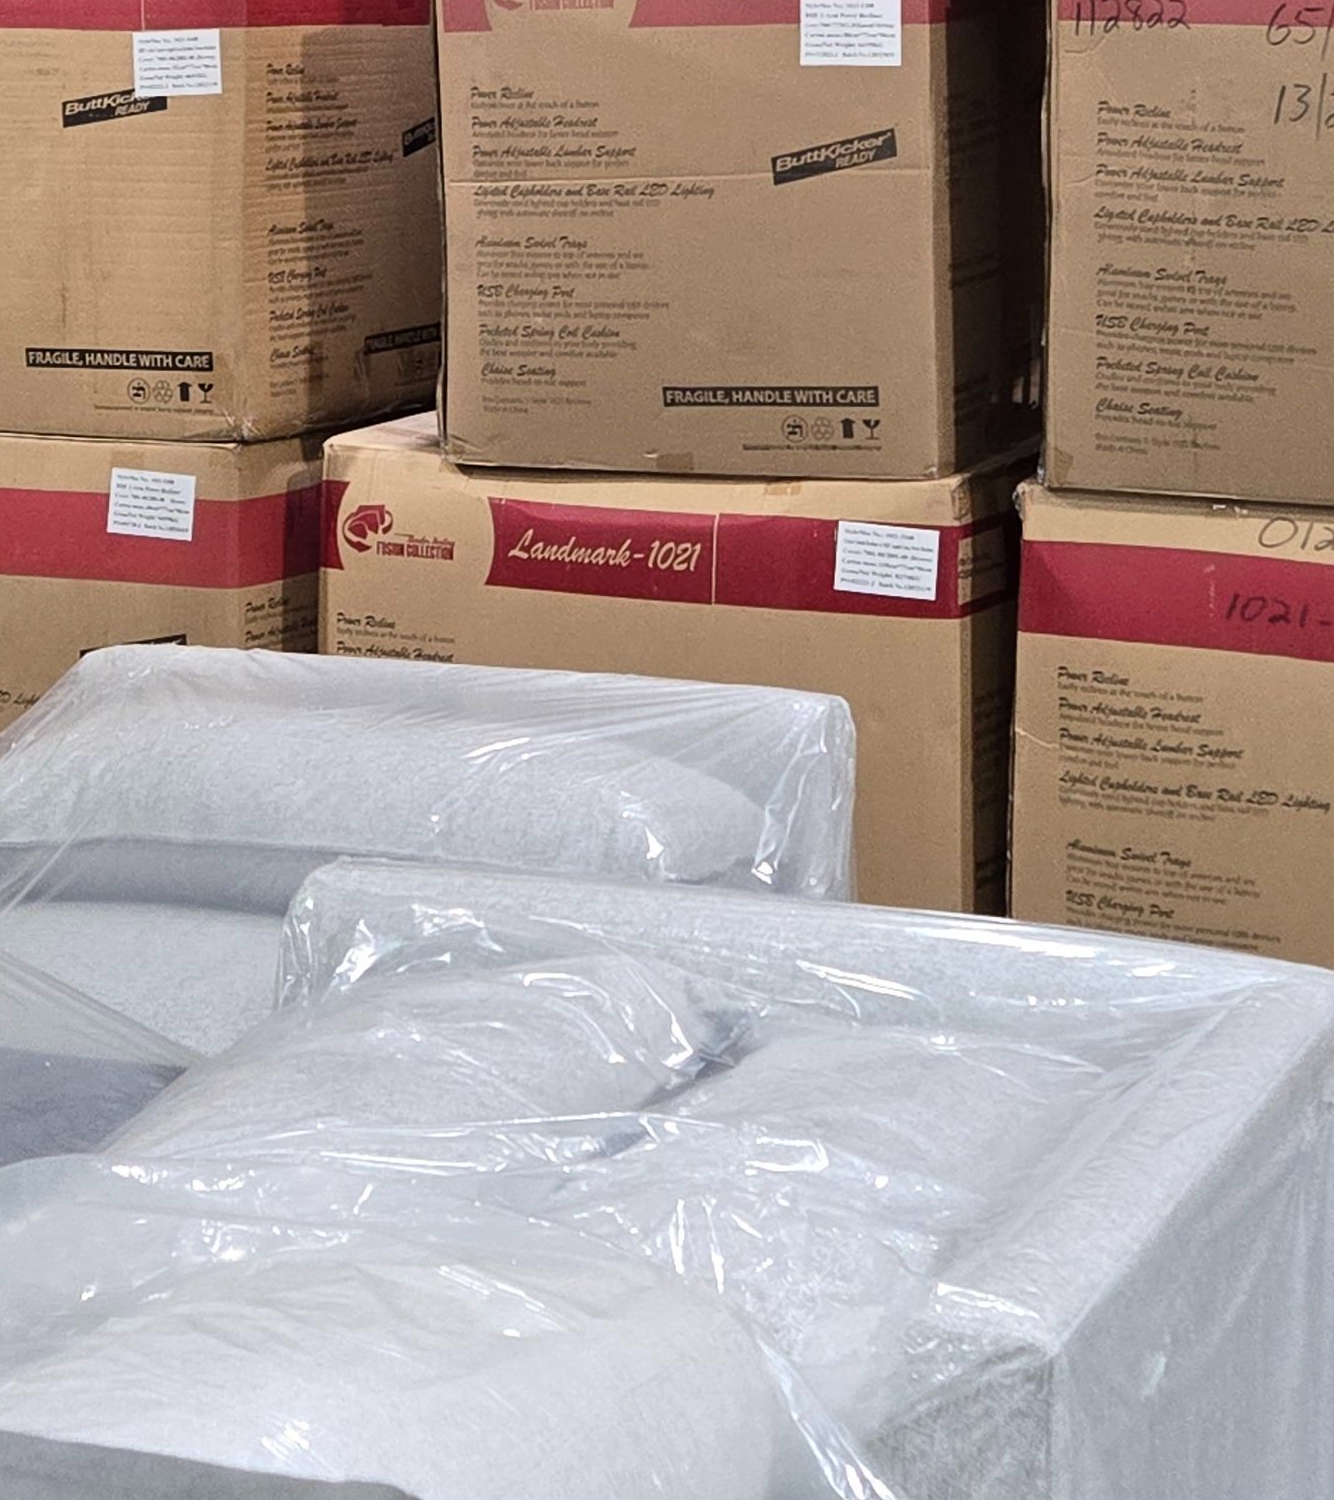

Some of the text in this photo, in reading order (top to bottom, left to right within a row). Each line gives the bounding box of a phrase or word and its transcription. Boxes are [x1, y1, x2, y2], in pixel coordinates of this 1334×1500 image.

[115, 100, 151, 115] READY
[776, 132, 891, 173] ButtKicker
[836, 149, 877, 171] READY
[28, 350, 210, 369] FRAGILE, HANDLE WITH CARE
[666, 389, 876, 405] FRAGILE, HANDLE WITH CARE
[406, 542, 455, 561] COLLECTION
[509, 530, 703, 572] Landmark-1021
[336, 611, 361, 625] Power
[336, 640, 455, 663] Power Adjustable Headrest
